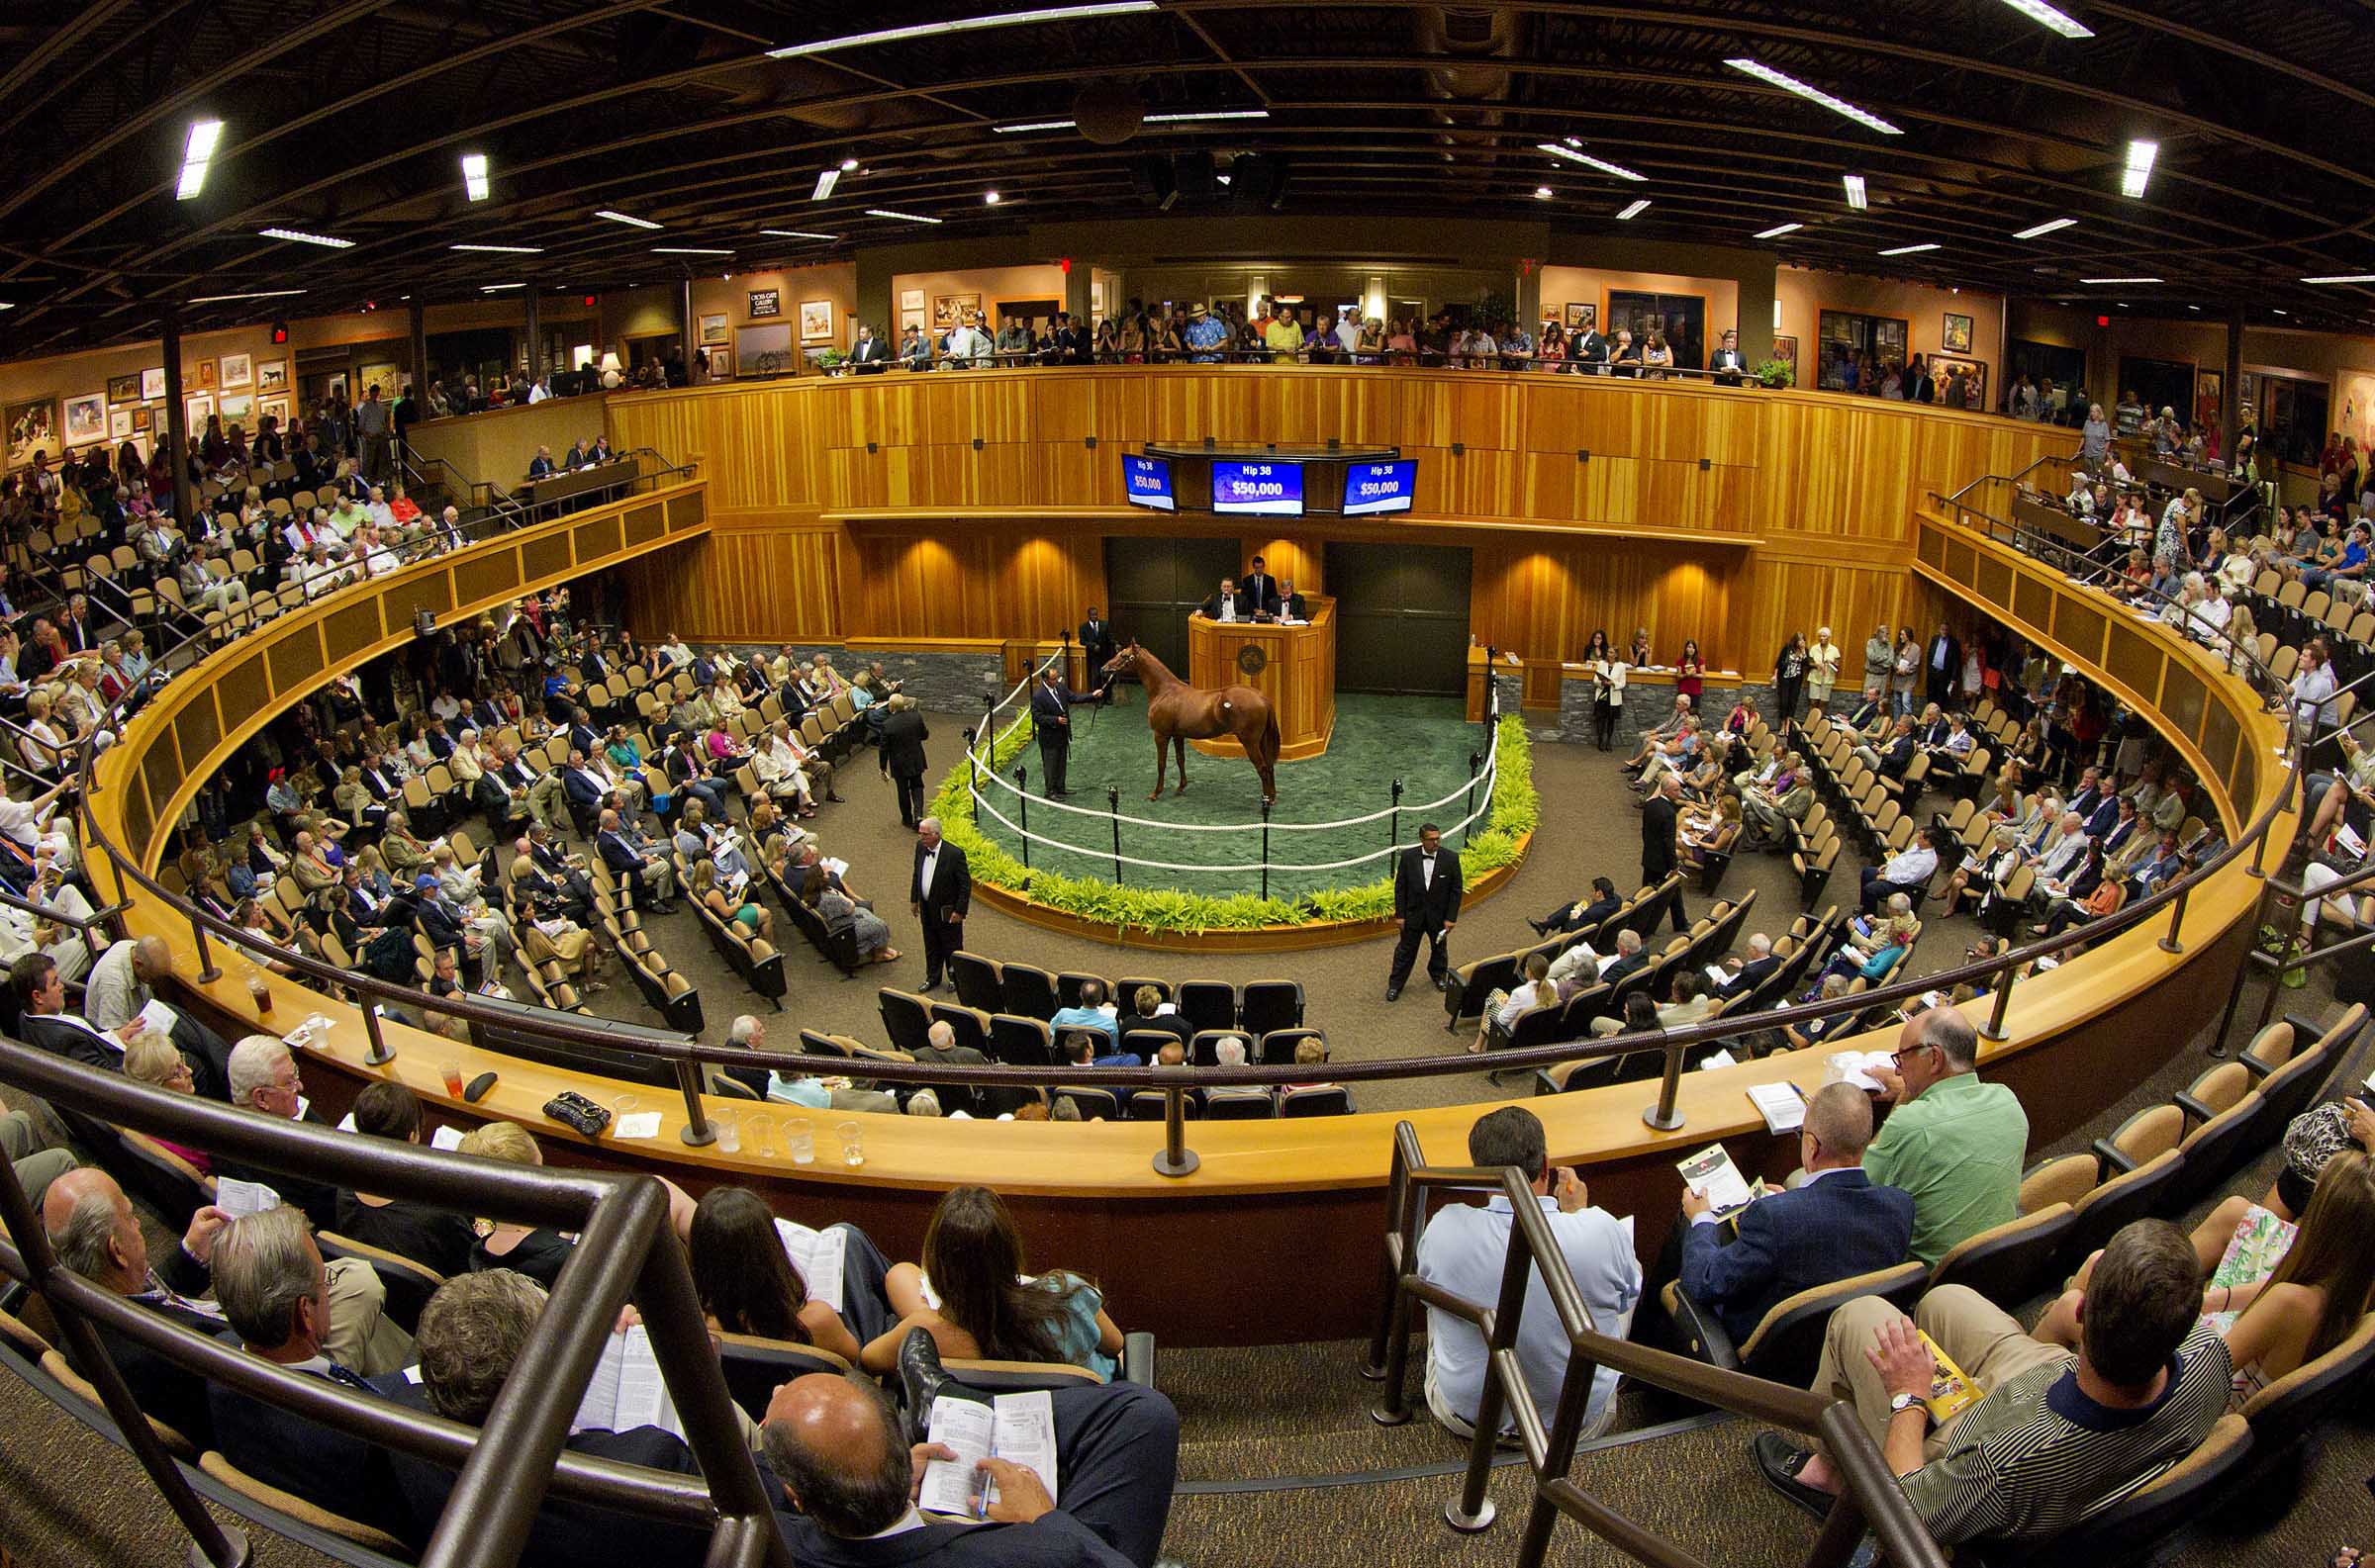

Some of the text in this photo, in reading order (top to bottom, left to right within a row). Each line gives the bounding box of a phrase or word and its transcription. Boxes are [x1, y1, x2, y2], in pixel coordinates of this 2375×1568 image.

[1243, 466, 1272, 477] Hip 38
[1371, 466, 1393, 476] Hip 38
[1135, 475, 1161, 491] $50,000
[1232, 481, 1282, 497] $50,000
[1361, 481, 1398, 496] $50,000
